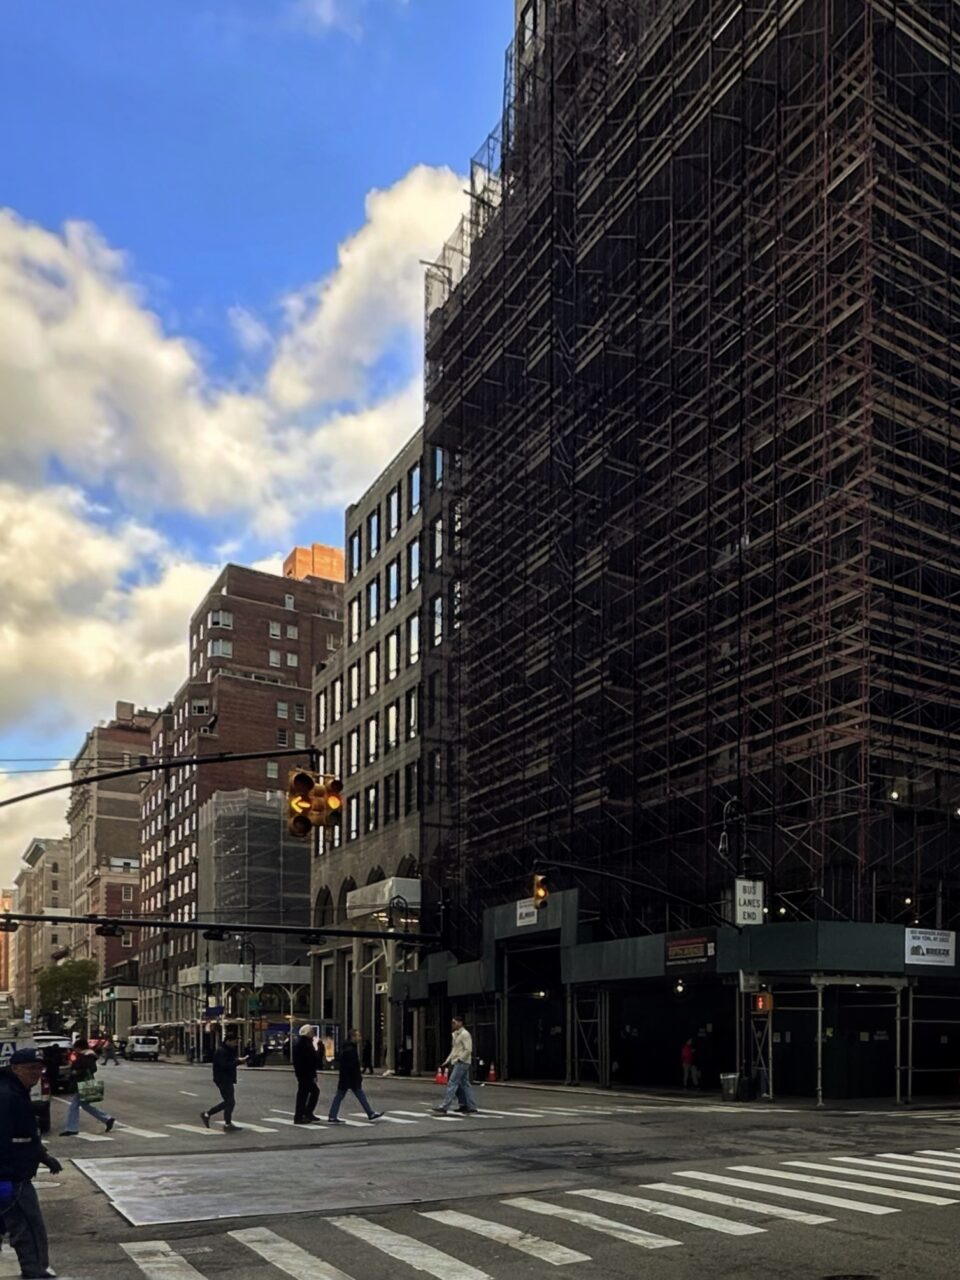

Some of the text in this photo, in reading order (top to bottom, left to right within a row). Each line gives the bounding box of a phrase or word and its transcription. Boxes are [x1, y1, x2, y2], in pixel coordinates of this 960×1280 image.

[743, 885, 757, 895] BUS
[739, 897, 761, 908] LANES
[743, 911, 757, 920] END
